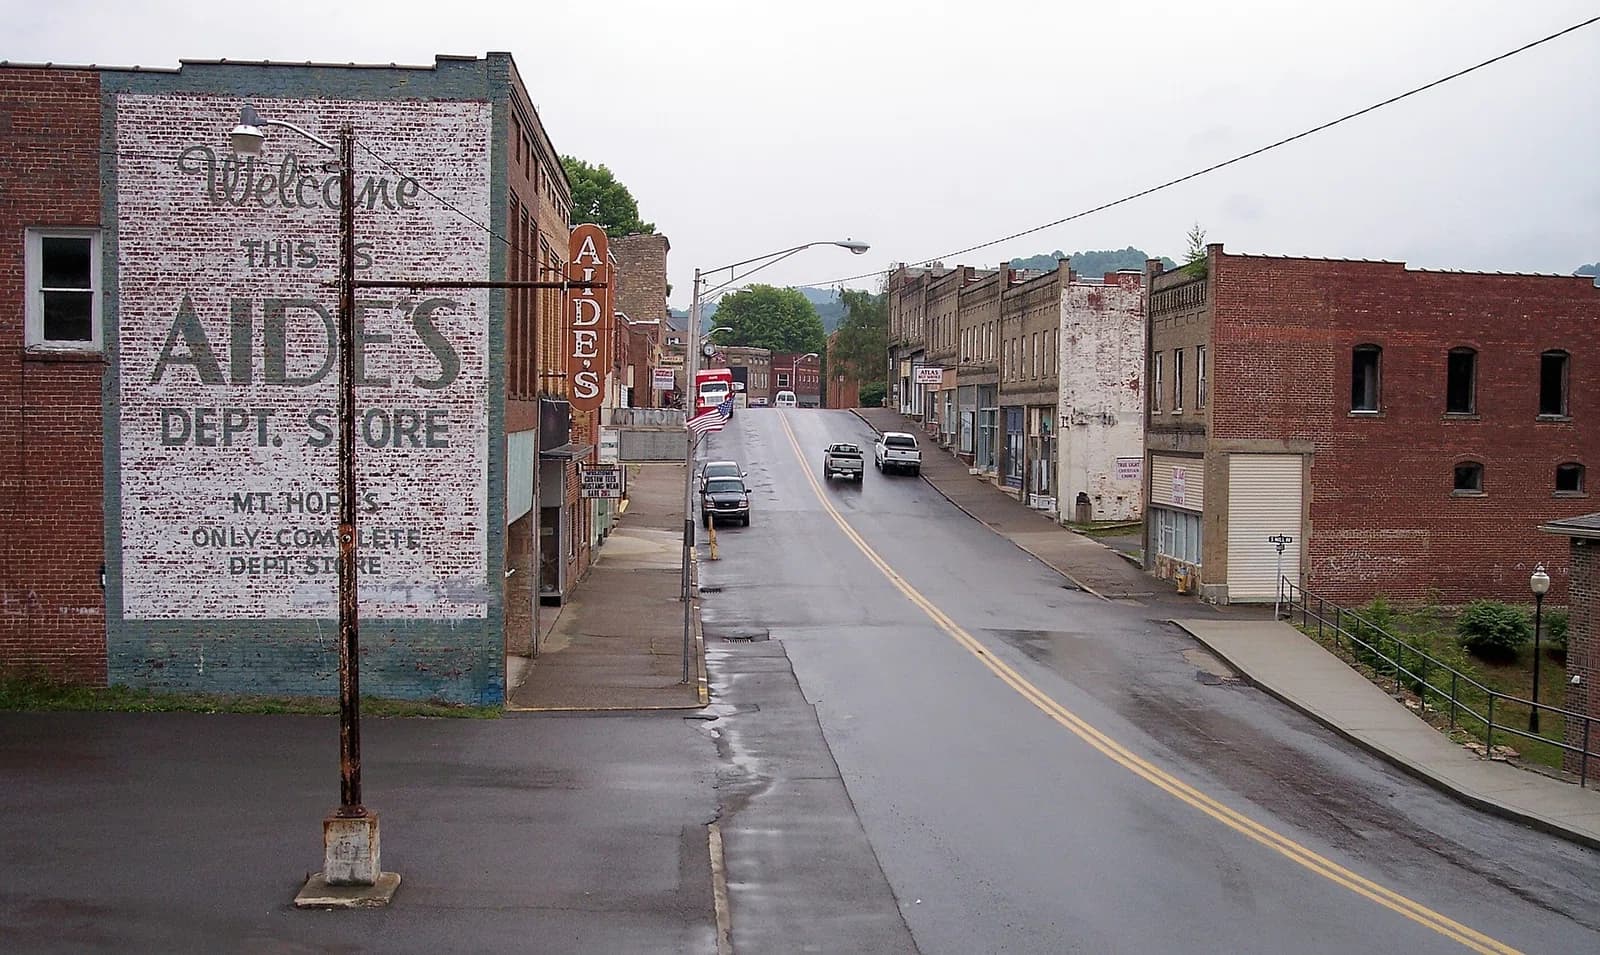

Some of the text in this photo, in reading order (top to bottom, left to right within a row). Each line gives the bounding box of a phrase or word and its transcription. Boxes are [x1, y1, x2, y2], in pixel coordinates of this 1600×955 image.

[177, 145, 421, 211] Welcome
[240, 238, 318, 269] THIS
[572, 236, 603, 399] AIDE'S
[151, 291, 461, 390] AIDE'S
[160, 407, 283, 448] DEPT.
[286, 490, 379, 514] HOP'S
[192, 527, 421, 549] ONLY COMLETE
